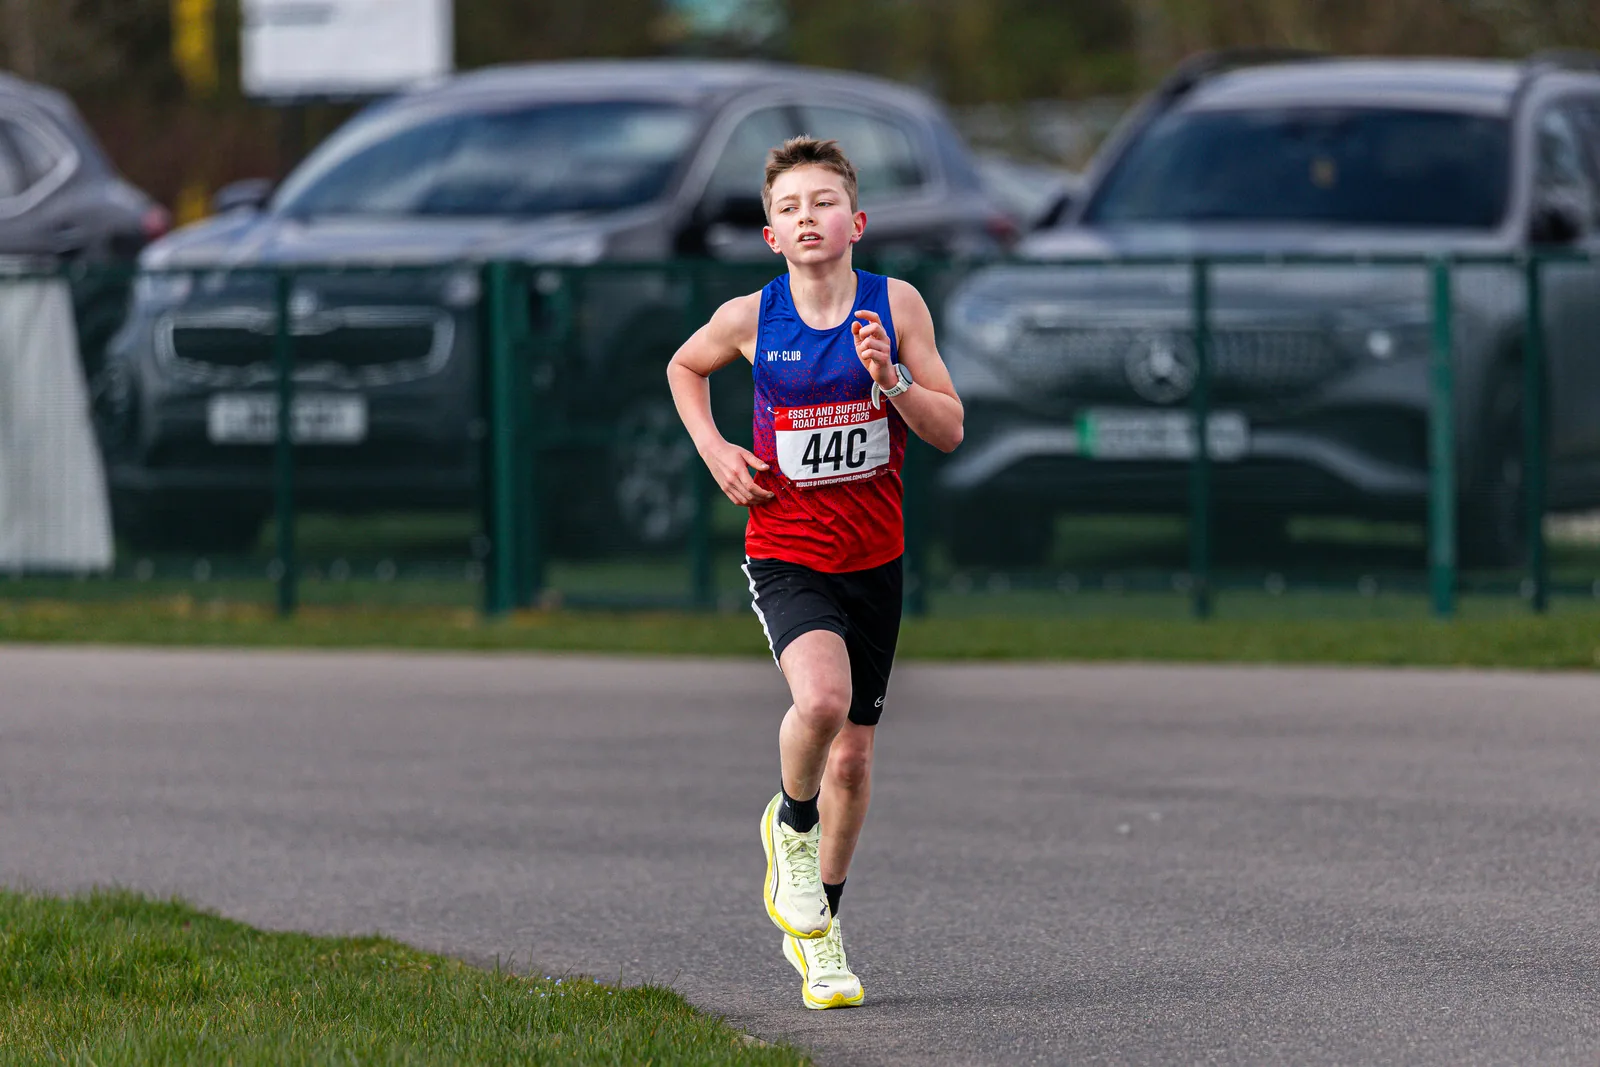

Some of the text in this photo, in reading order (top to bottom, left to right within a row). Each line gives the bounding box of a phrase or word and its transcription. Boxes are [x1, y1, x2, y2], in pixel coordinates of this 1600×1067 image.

[788, 401, 872, 419] ESSEX AND SUFFOLK
[792, 411, 870, 428] ROAD RELAYS 2026
[801, 428, 867, 474] 44C
